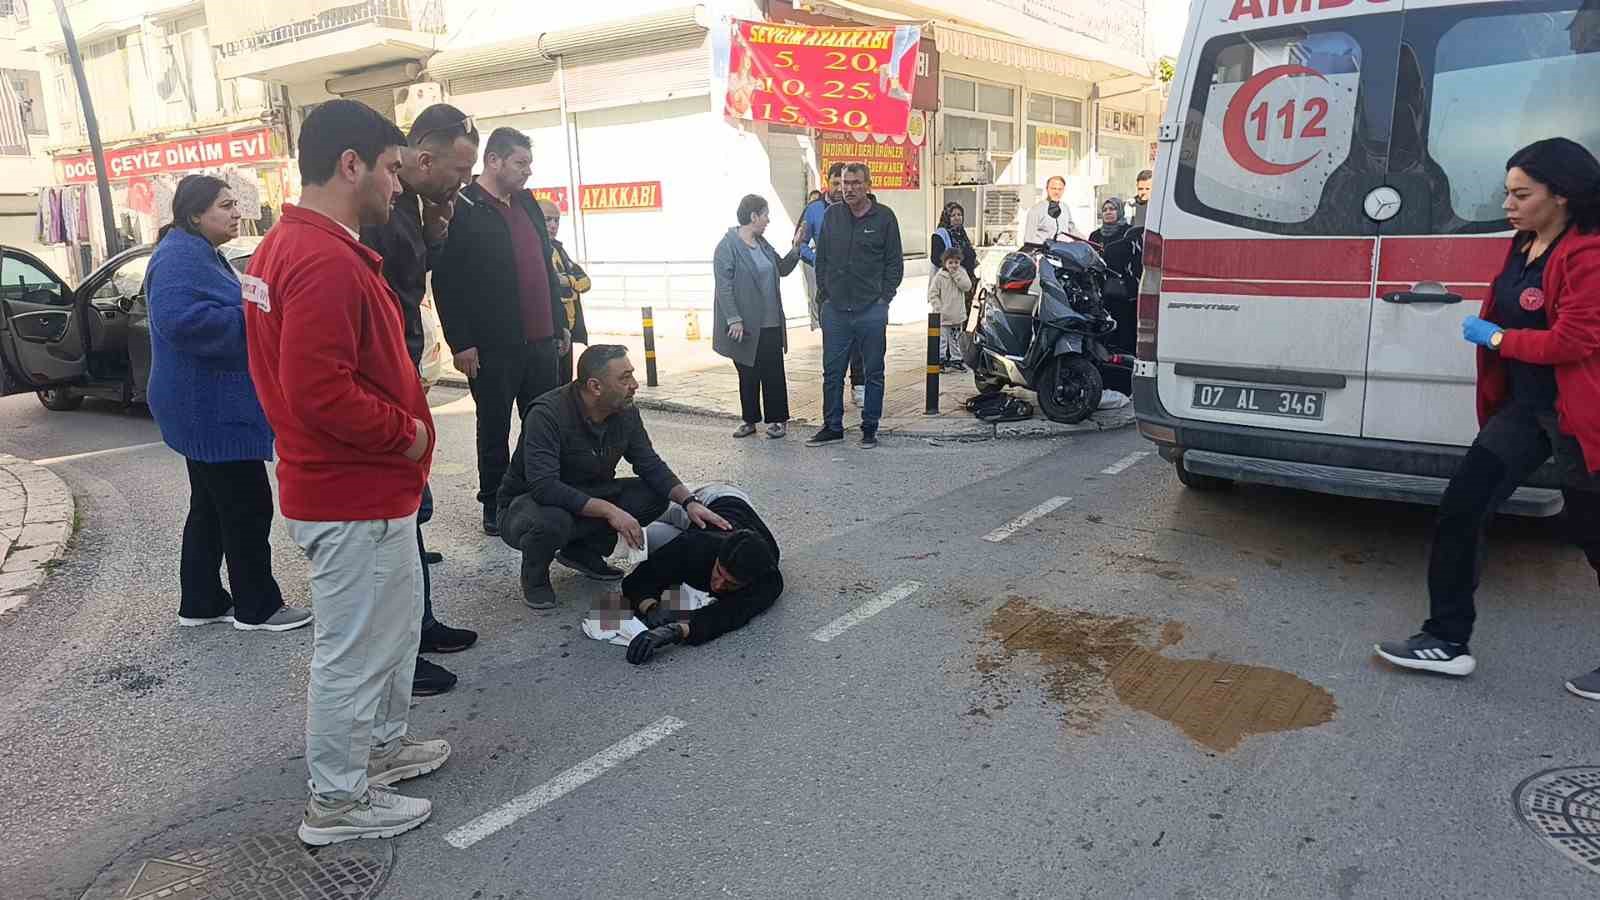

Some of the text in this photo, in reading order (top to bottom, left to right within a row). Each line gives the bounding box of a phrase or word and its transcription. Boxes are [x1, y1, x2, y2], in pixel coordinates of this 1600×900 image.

[803, 31, 892, 49] AYAKKABI
[1250, 97, 1328, 141] 112
[65, 132, 266, 178] DOĞ ÇEYİZ DİKİM EVİ
[582, 185, 657, 208] AYAKKABI
[1201, 386, 1317, 415] 07 AL 346
